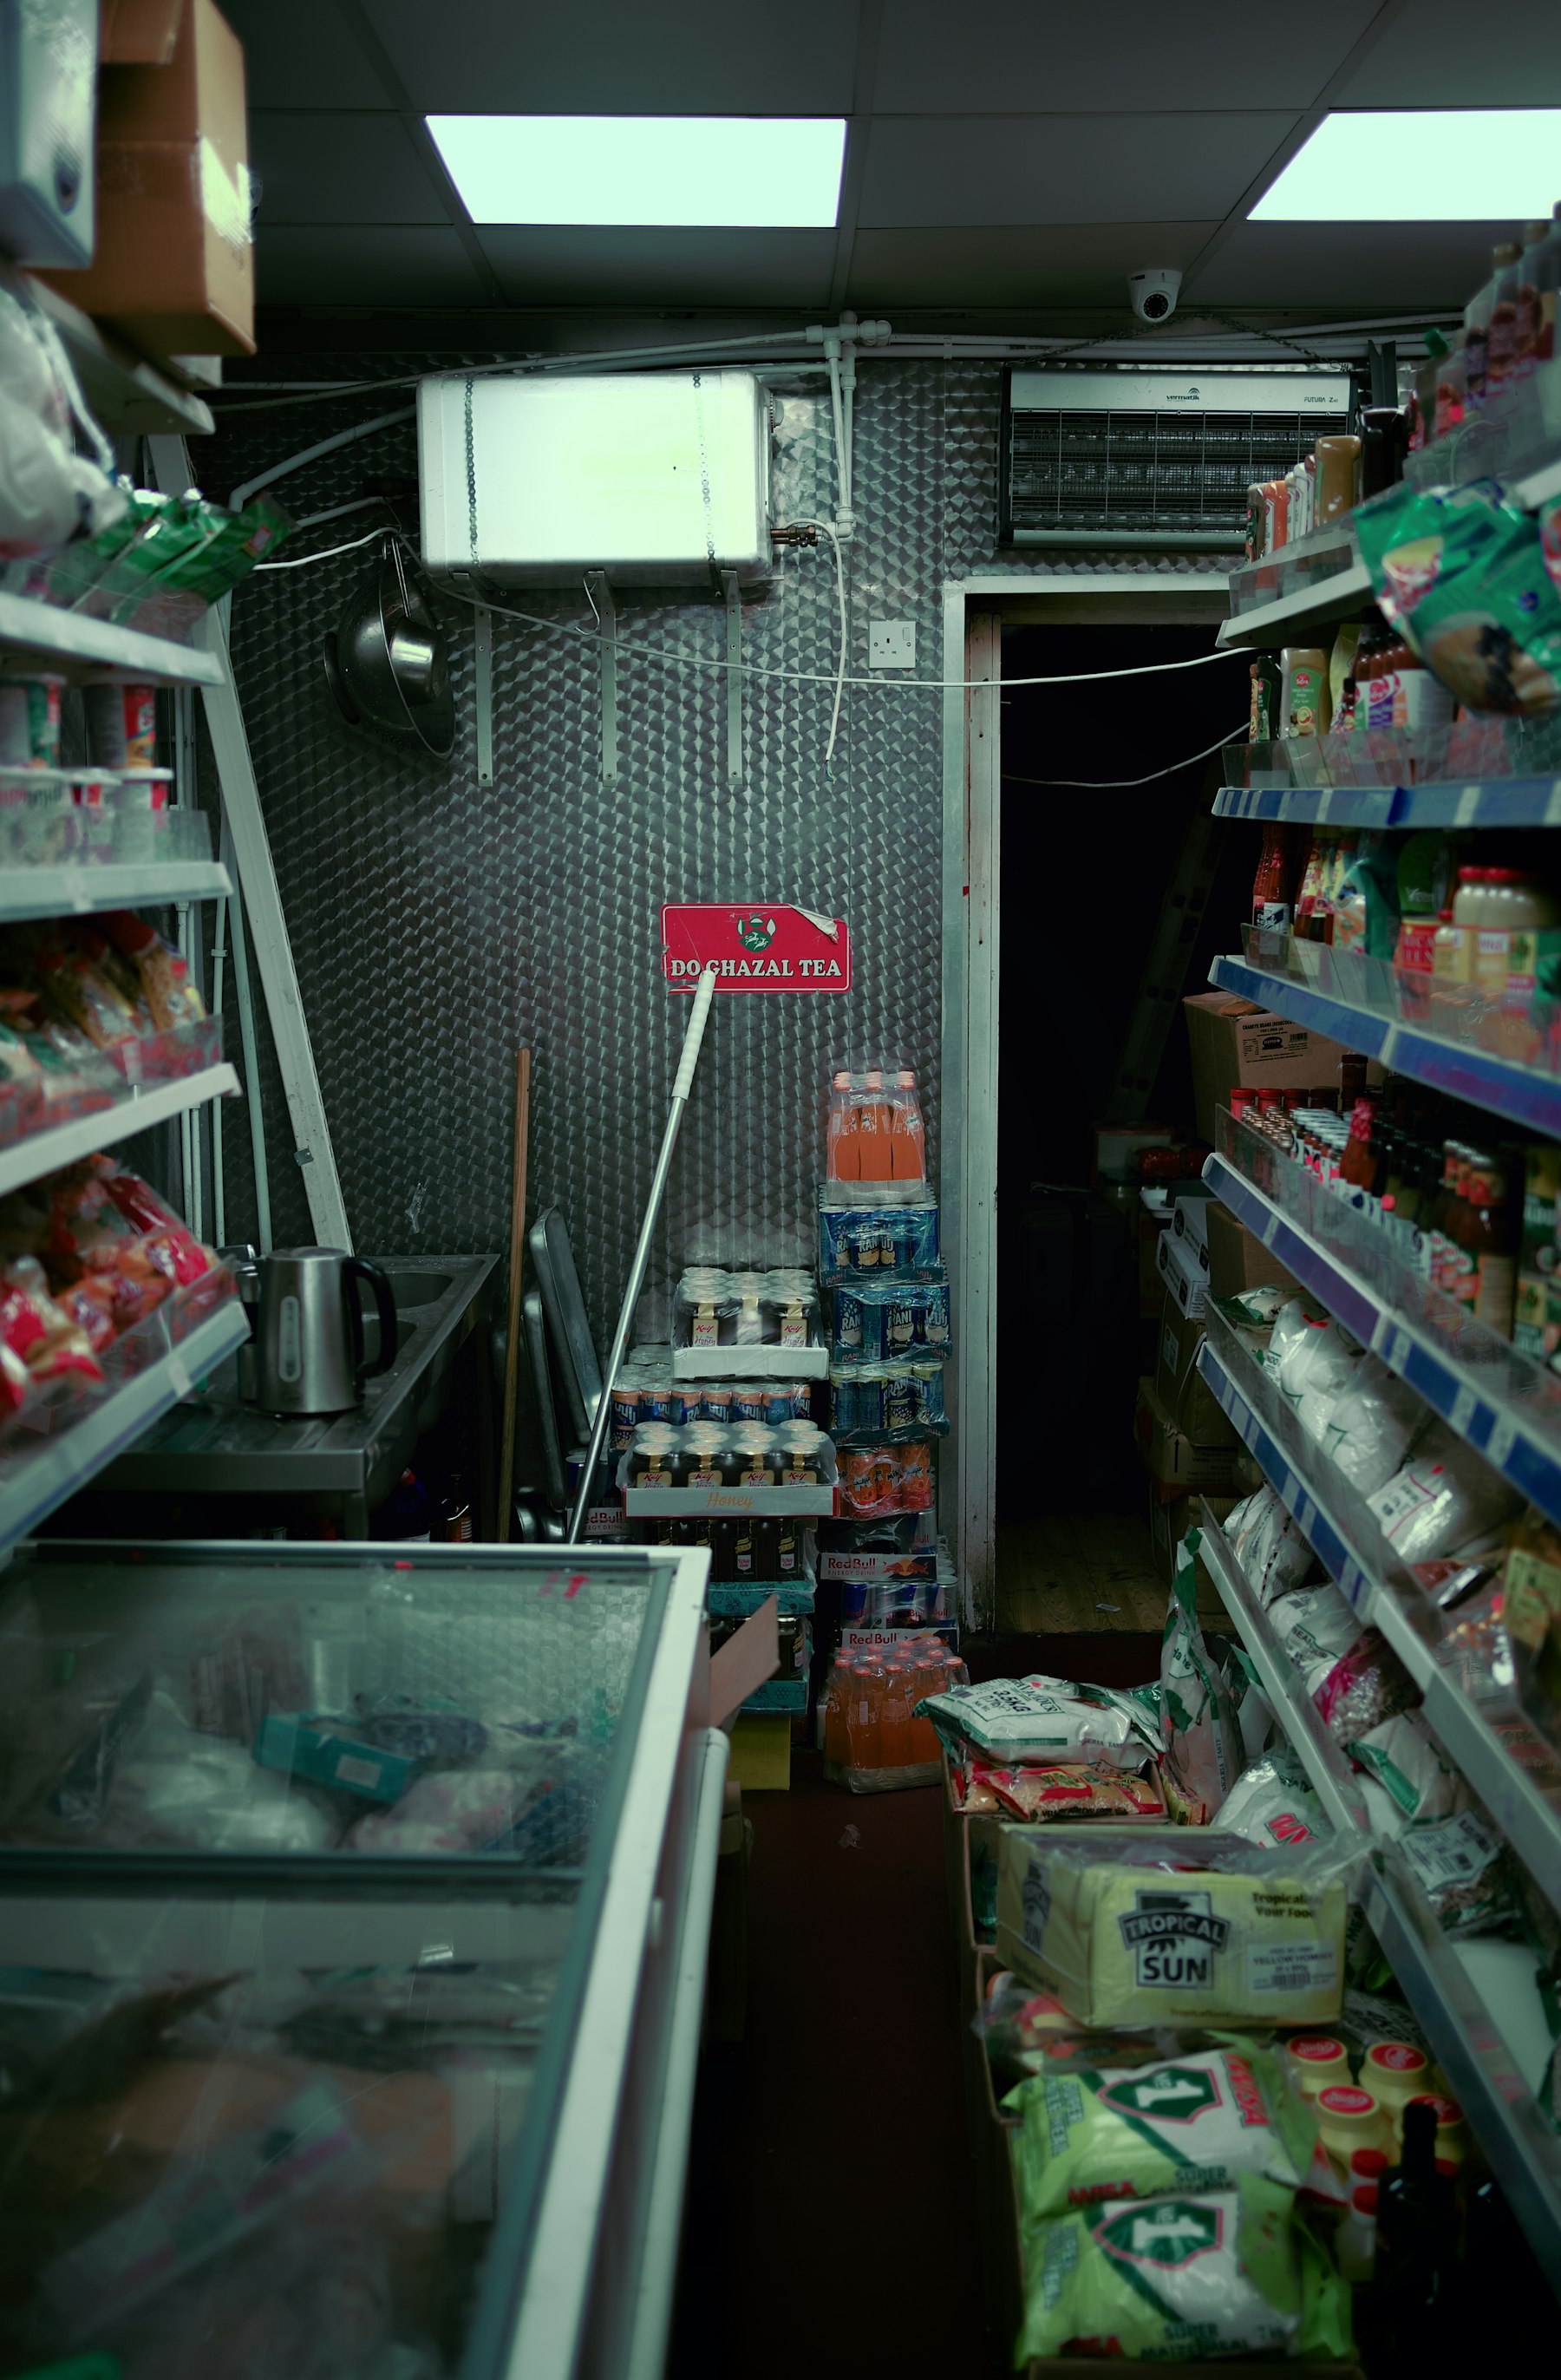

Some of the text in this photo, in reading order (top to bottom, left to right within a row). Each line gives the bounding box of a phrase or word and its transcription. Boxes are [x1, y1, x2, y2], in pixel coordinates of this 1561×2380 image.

[670, 958, 842, 978] DO GHAZAL TEA
[841, 1315, 861, 1331] RAN
[892, 1310, 912, 1326] RANI
[694, 1336, 716, 1346] Honey
[783, 1336, 805, 1347] Honey
[707, 1491, 754, 1511] Honey
[585, 1511, 622, 1524] ed Bull
[827, 1558, 876, 1569] Red Bull
[849, 1631, 898, 1645] Red Bull
[1108, 1741, 1125, 1749] TAST
[1220, 1762, 1229, 1794] NIGERIA
[1252, 1893, 1306, 1906] Tropical
[1127, 1914, 1225, 1941] TROPICAL
[1144, 1956, 1208, 1982] SUN
